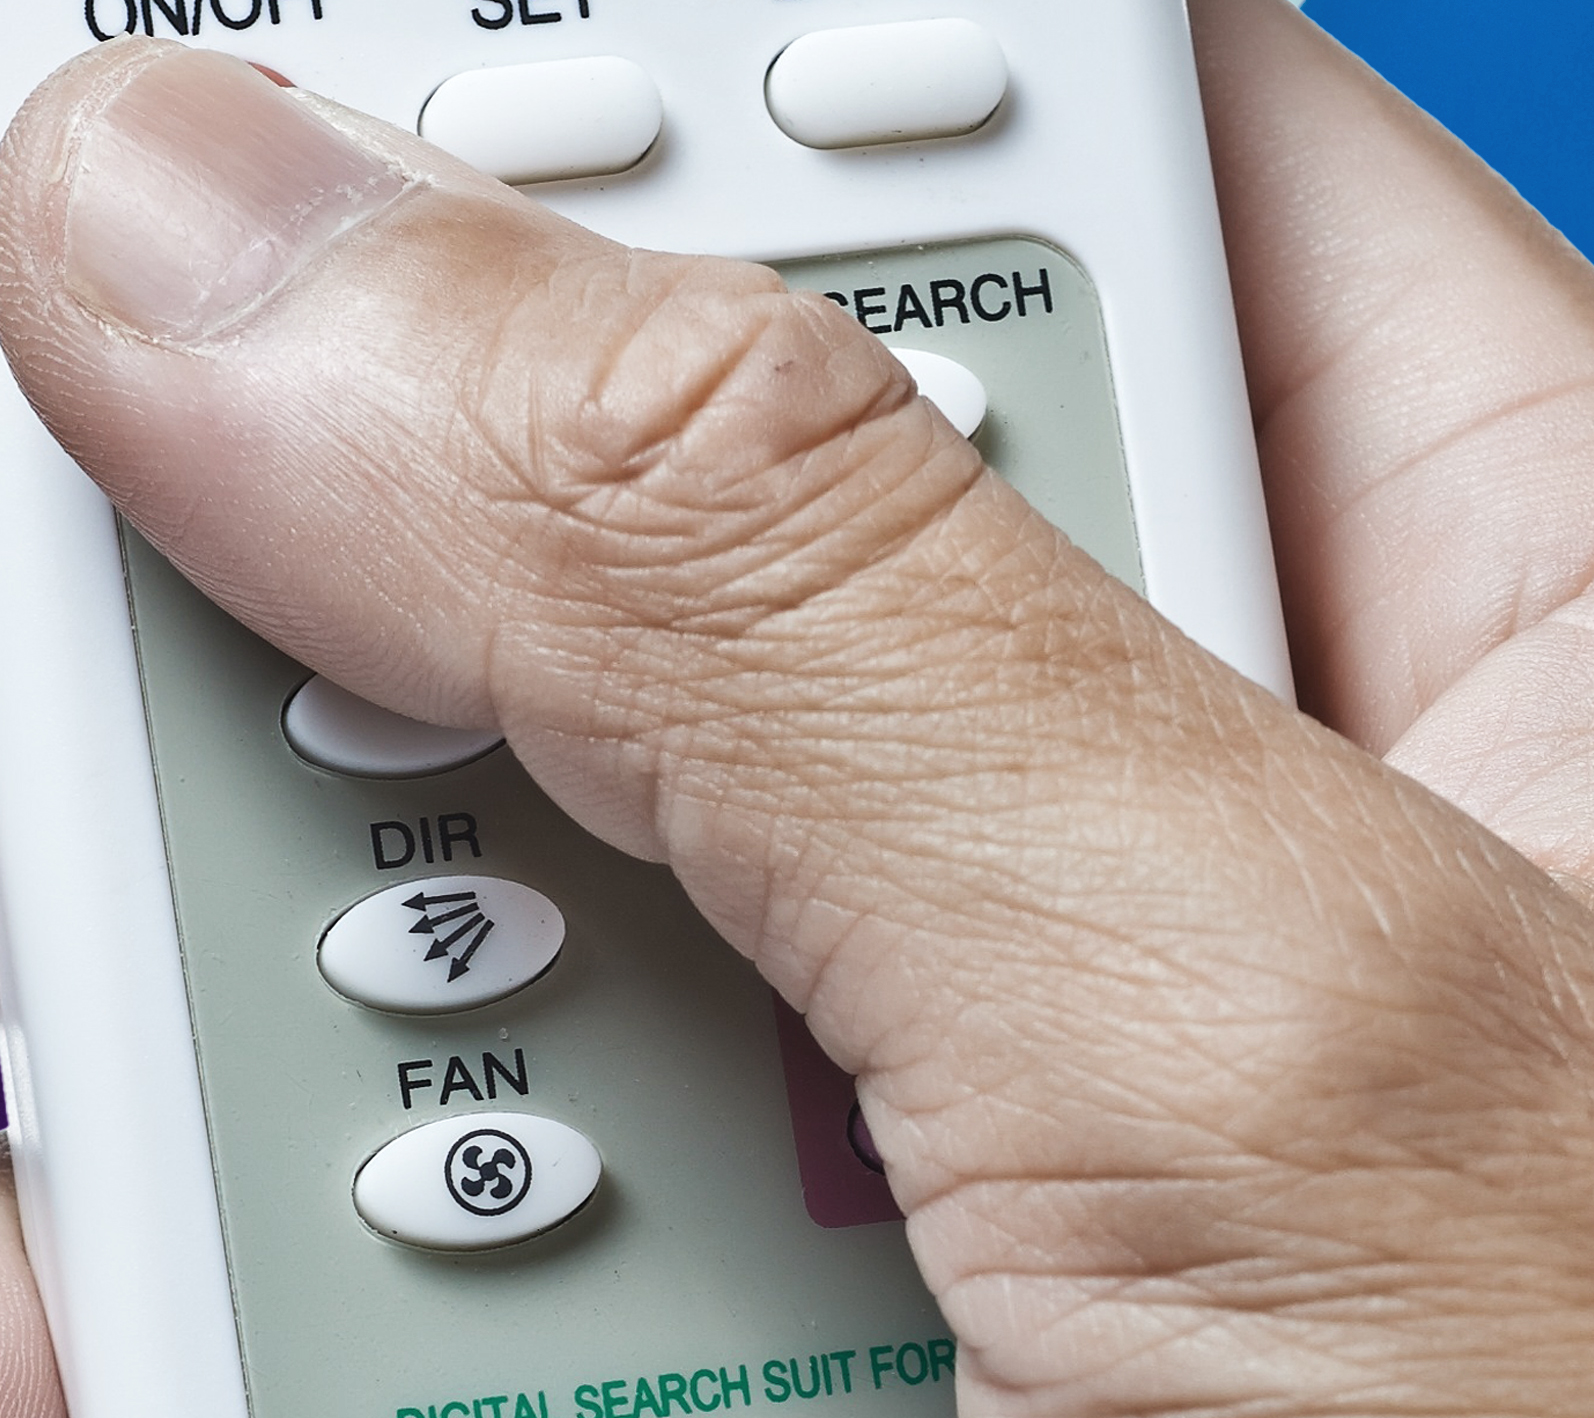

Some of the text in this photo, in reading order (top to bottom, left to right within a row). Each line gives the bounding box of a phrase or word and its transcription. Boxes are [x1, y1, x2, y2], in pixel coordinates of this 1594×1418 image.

[370, 811, 482, 871] DIR
[397, 1047, 530, 1110] FAN
[762, 1349, 856, 1404] SUIT
[869, 1338, 956, 1390] FOR
